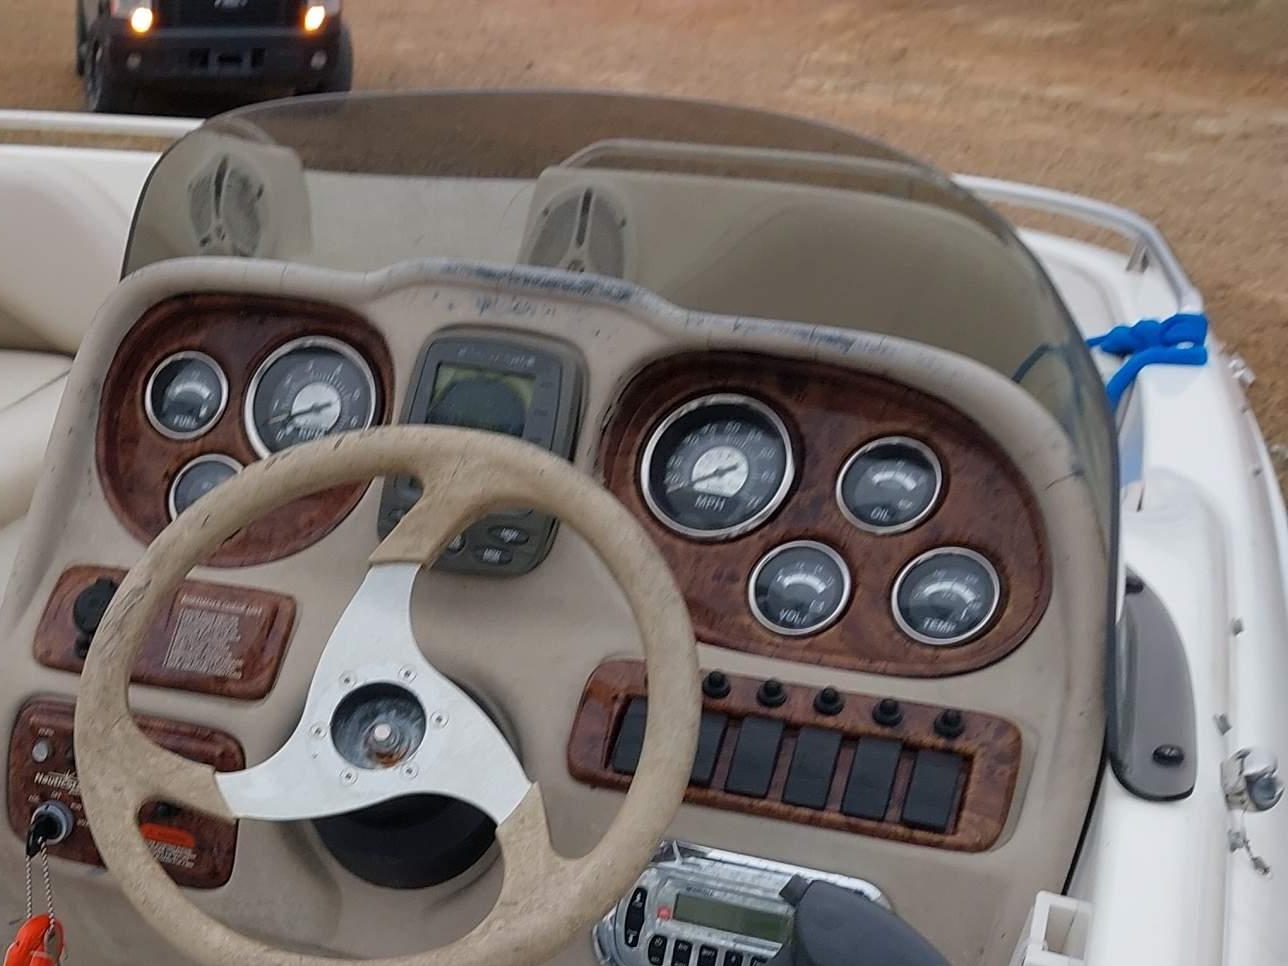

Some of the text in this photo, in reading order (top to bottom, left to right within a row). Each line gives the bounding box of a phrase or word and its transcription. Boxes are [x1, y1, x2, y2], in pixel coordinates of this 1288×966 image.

[694, 494, 727, 512] MPH
[870, 505, 890, 522] OIL
[922, 616, 958, 634] TEMP
